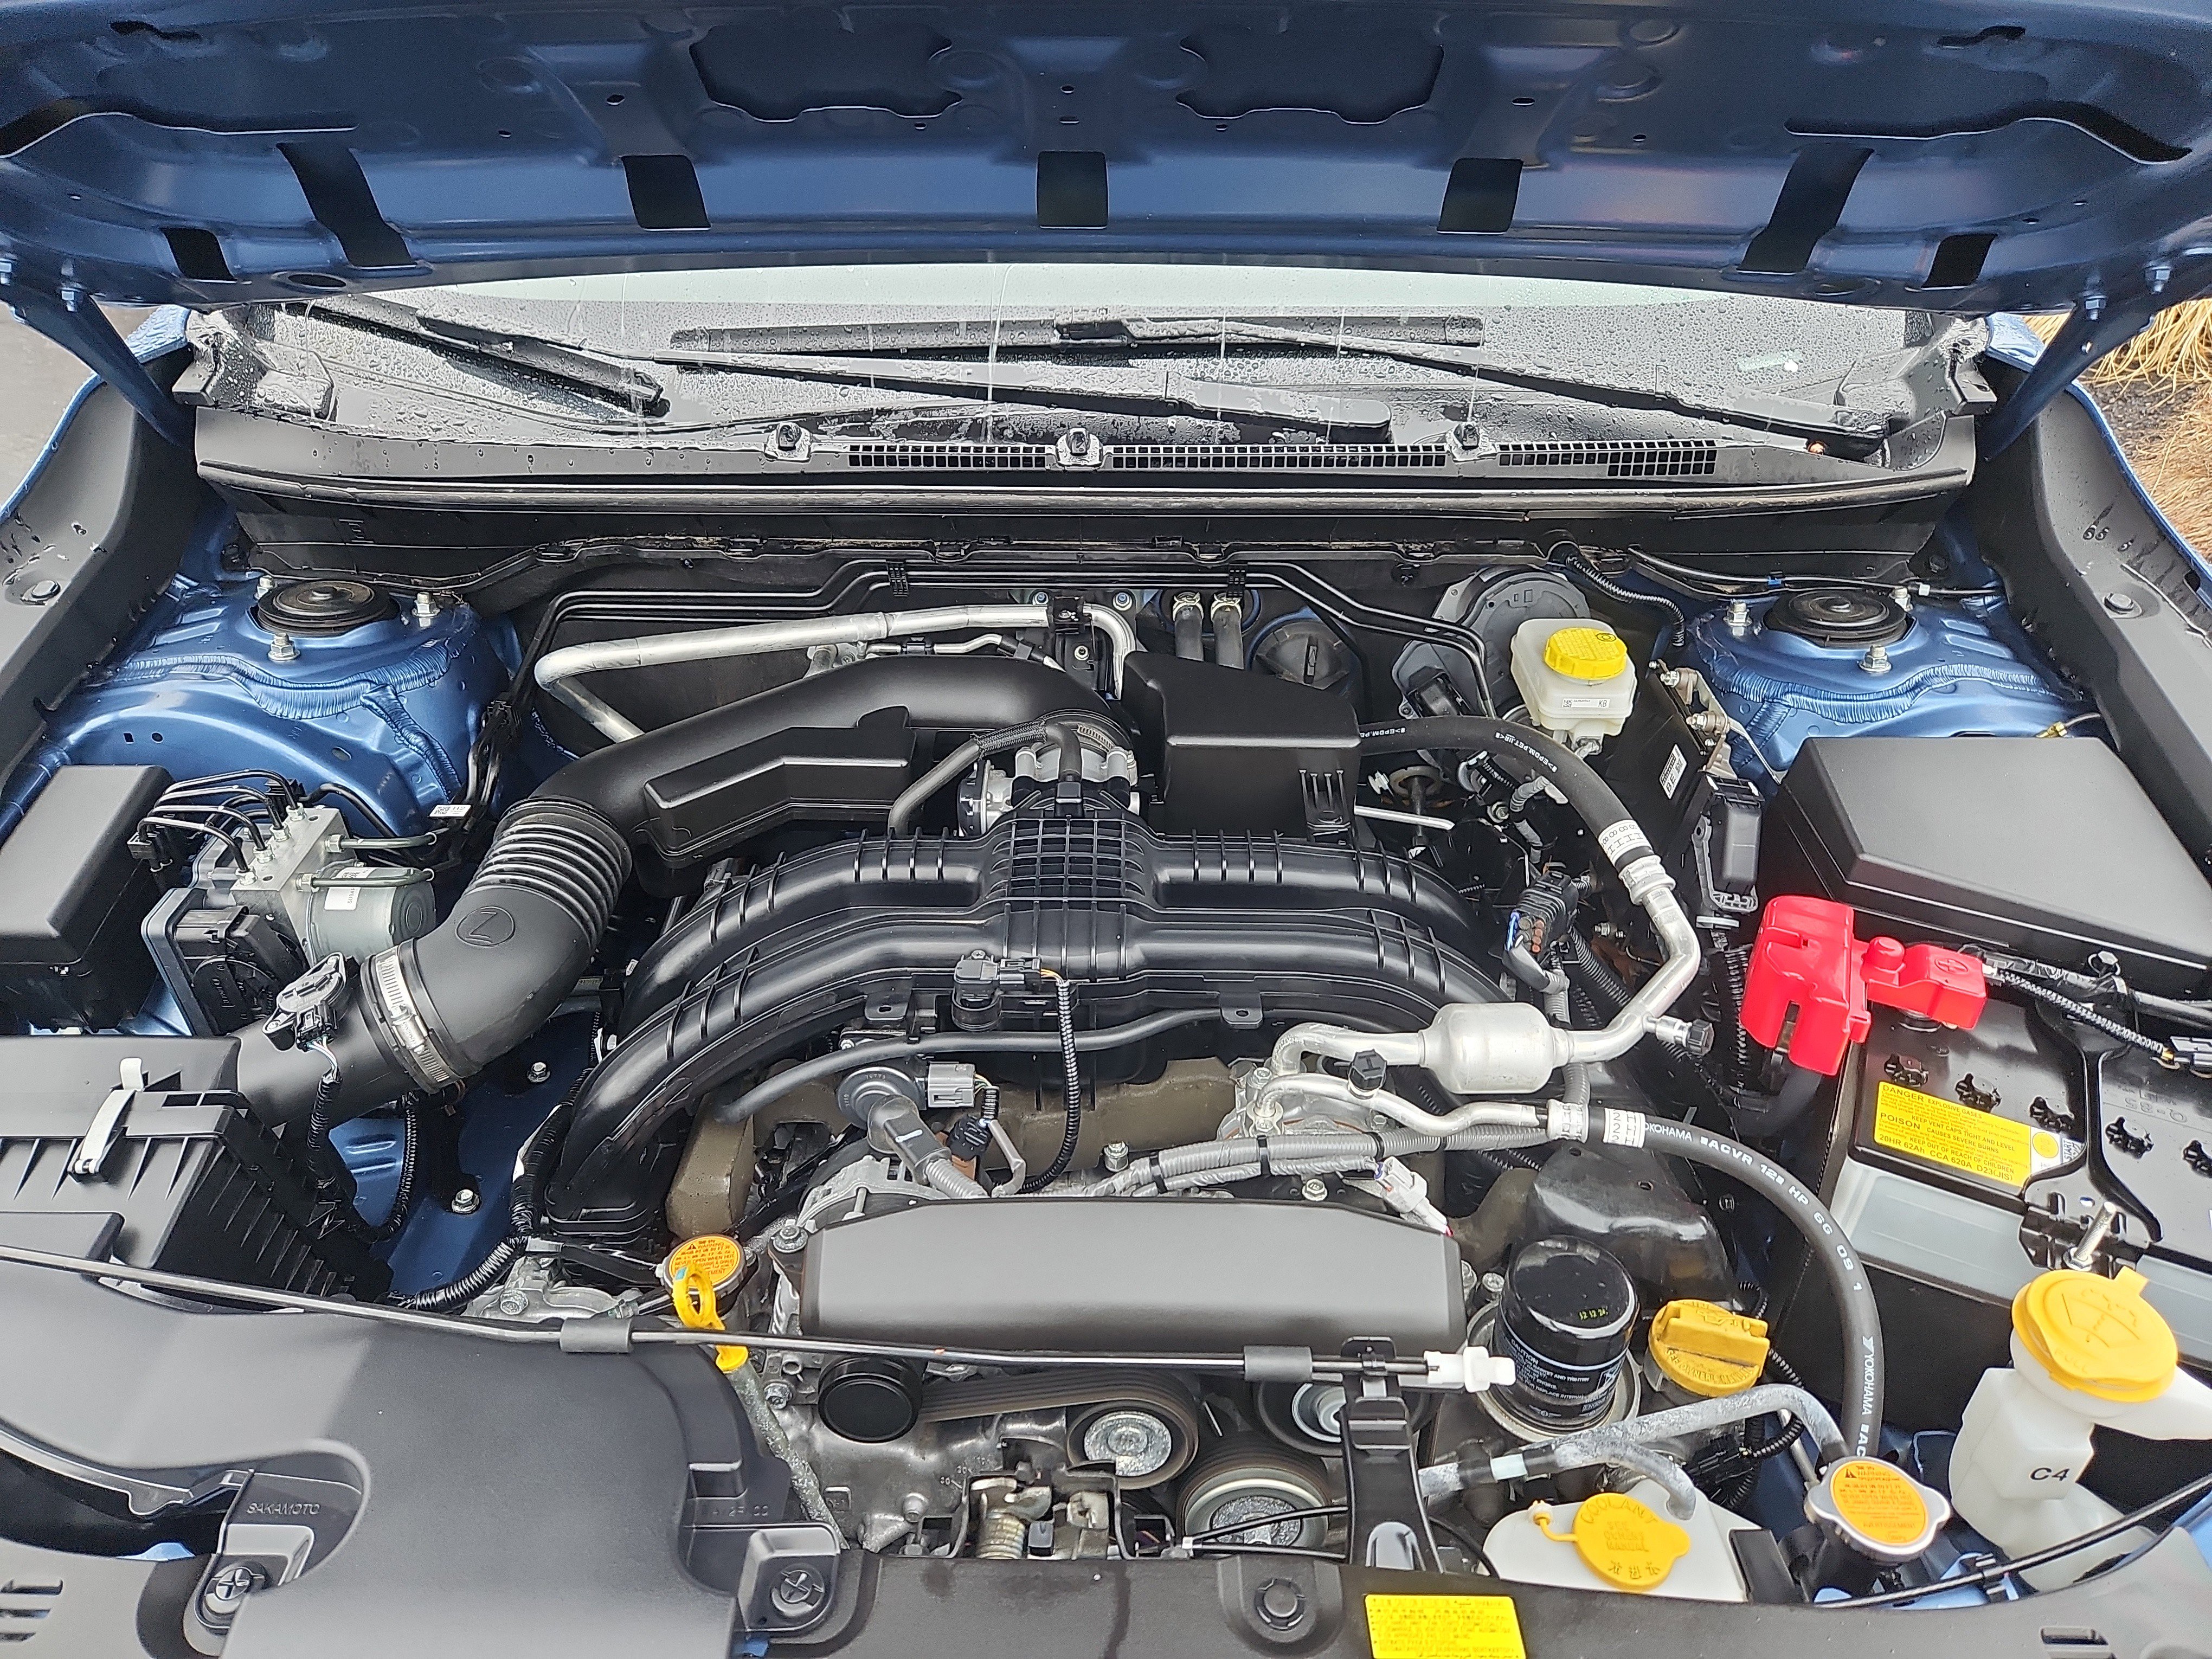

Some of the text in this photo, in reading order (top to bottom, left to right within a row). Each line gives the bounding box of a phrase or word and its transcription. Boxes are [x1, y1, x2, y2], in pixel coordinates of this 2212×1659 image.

[1883, 1084, 1982, 1118] DANGER EXPLOSIVE GASES
[1880, 1112, 1998, 1154] POISON CAUSES SEVERE BURNS
[1912, 1115, 2015, 1151] KEEP VENT CAPS TIGHT AND LEVEL
[2063, 1140, 2072, 1161] START
[1879, 1133, 2012, 1182] 20HR 62Ah CCA 620A D23(JIS)
[1909, 1136, 1925, 1146] KEEP
[1927, 1141, 1939, 1150] OUT
[1951, 1149, 1971, 1161] REACH
[1973, 1156, 1982, 1164] OF
[1983, 1159, 2014, 1174] CHILDREN
[1645, 1122, 1692, 1141] OKOHAMA
[1788, 1185, 1809, 1206] HP
[1814, 1212, 1834, 1234] 6G
[1853, 1282, 1862, 1291] 1
[1512, 1339, 1539, 1365] CAUTION
[1666, 1349, 1680, 1364] SEE
[1720, 1366, 1753, 1384] MANUAL
[1857, 1354, 1874, 1458] YOKOHAMA AC
[2030, 1467, 2070, 1481] C4
[246, 1502, 321, 1515] SAKAMOTO
[1581, 1497, 1658, 1524] COOLANT
